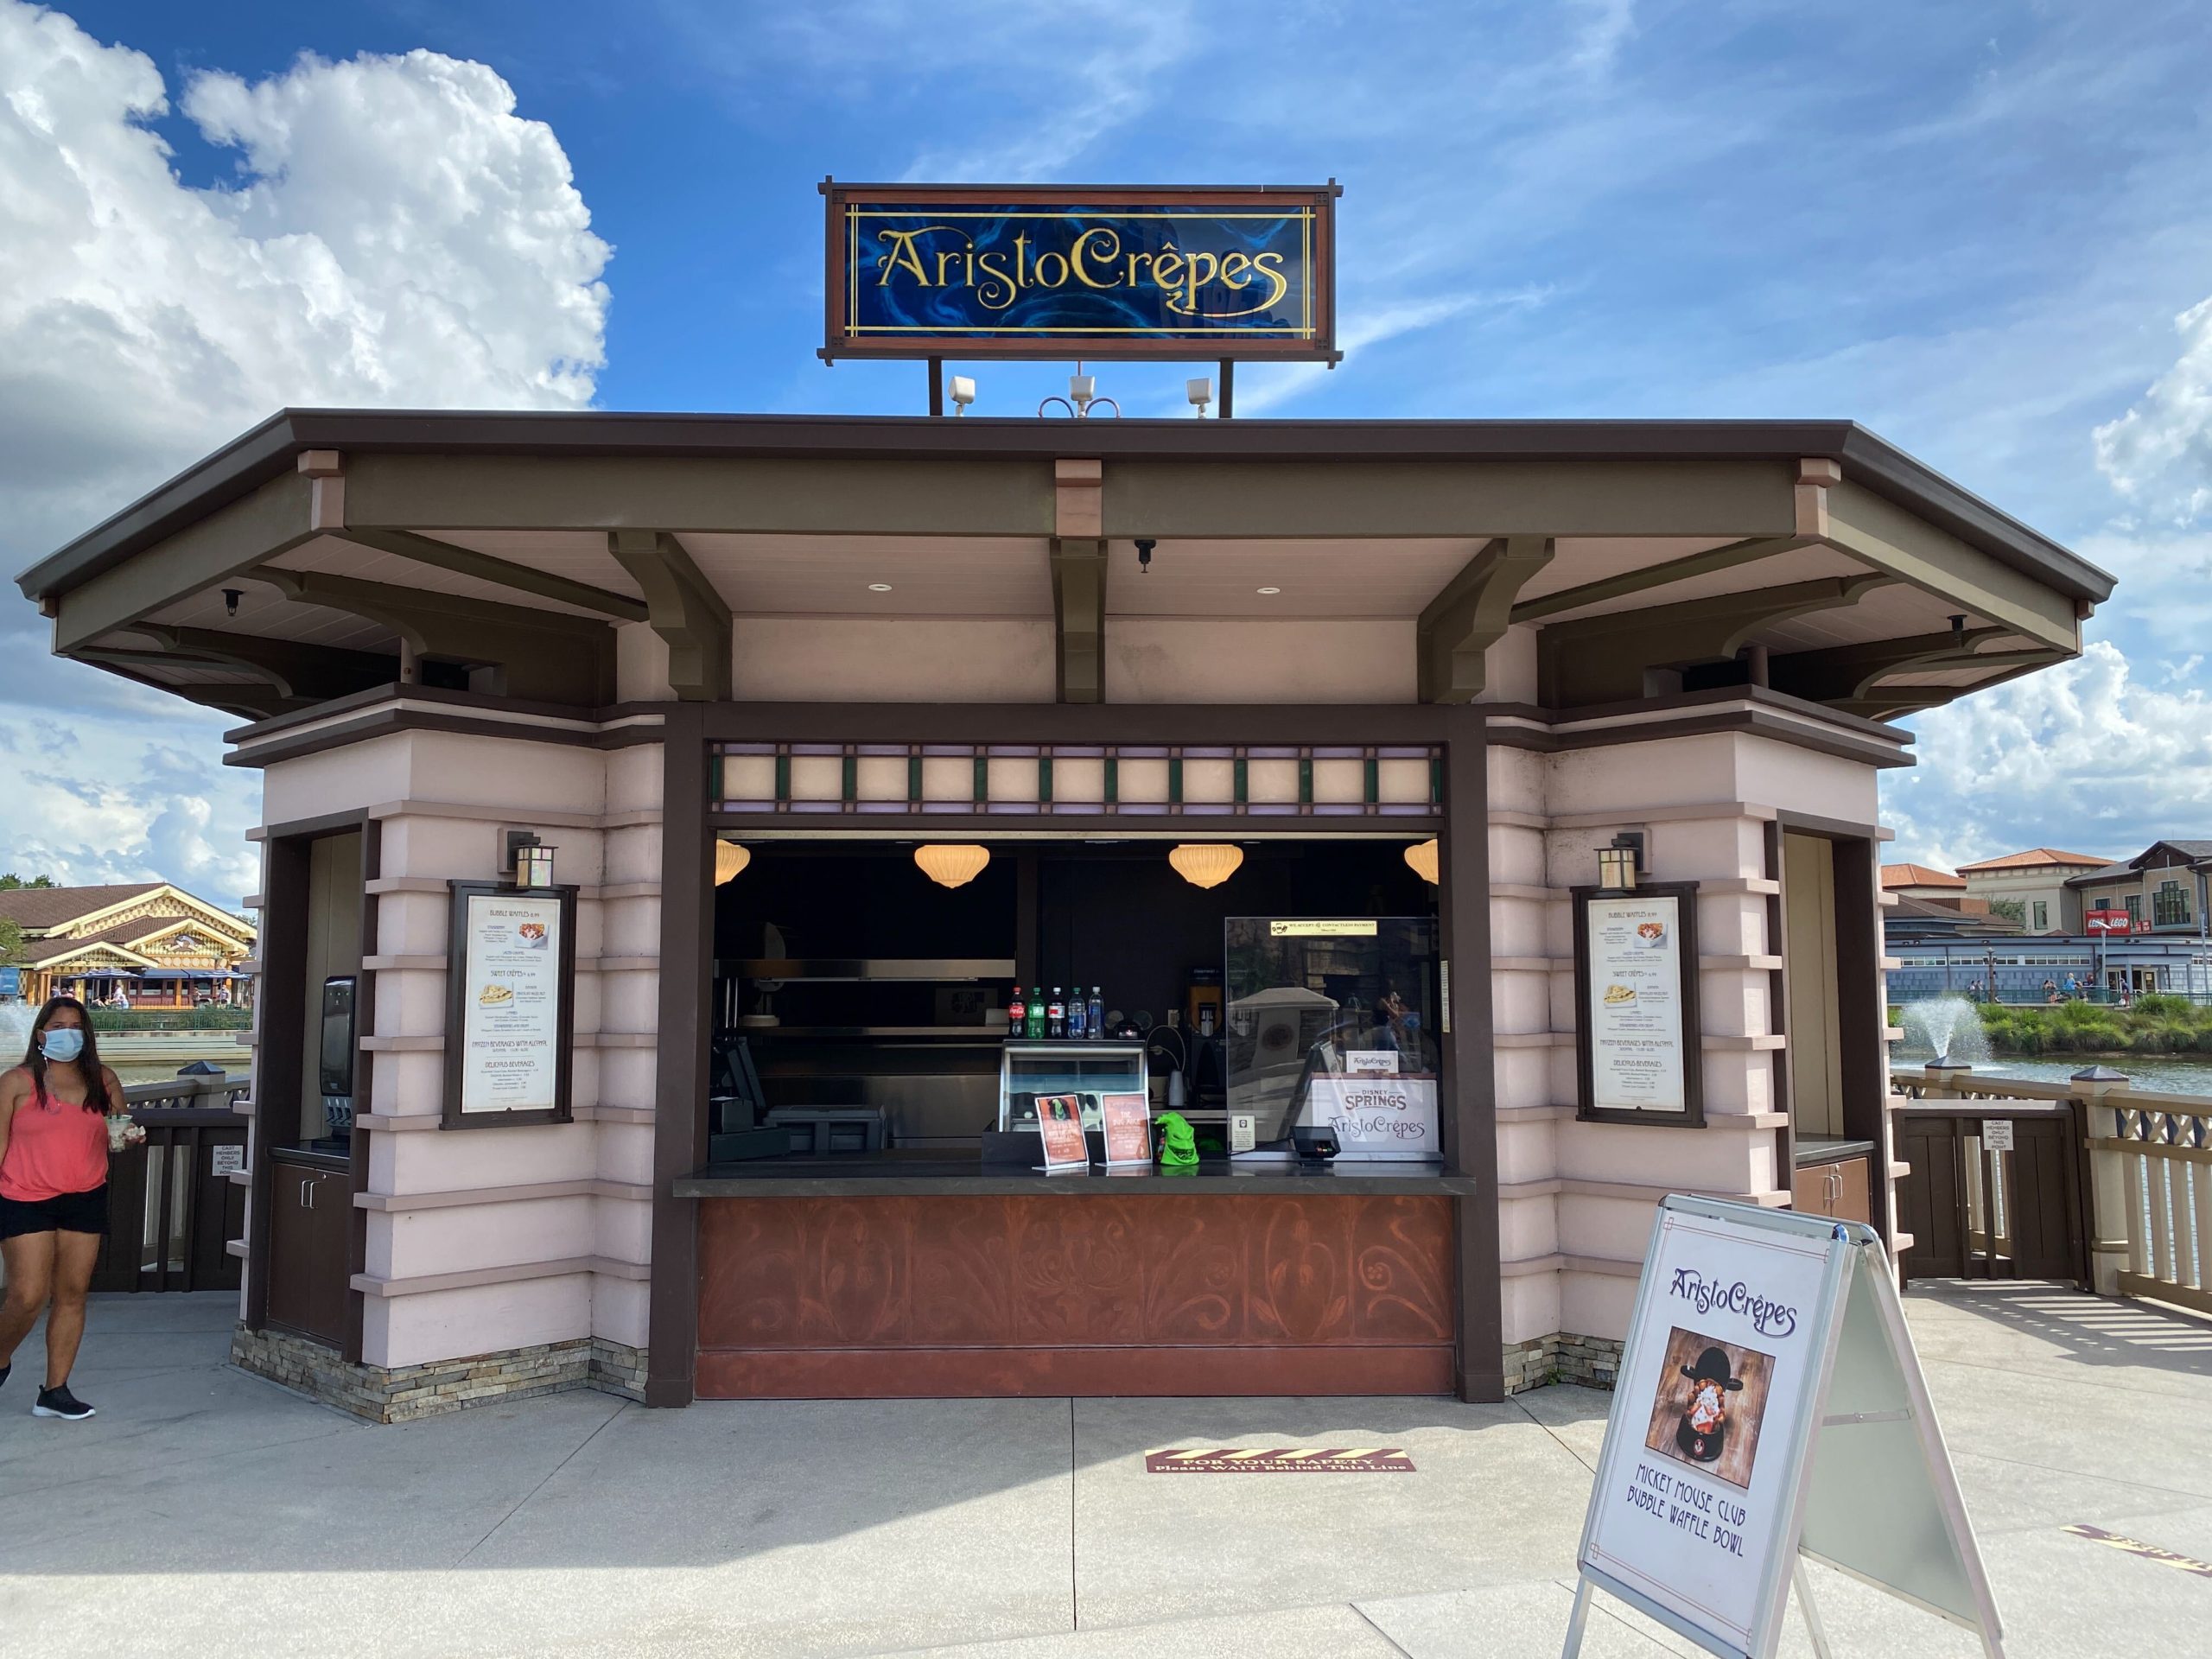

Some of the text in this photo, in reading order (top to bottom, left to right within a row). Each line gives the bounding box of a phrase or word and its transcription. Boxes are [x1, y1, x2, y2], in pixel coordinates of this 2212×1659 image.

[876, 226, 1287, 318] AristoCrêpes
[2110, 918, 2128, 927] LEGO
[1327, 1116, 1426, 1140] AristoCrêpes
[1345, 1095, 1407, 1111] SPRINGS
[1669, 1268, 1797, 1338] AristoCrêpes
[1627, 1485, 1743, 1557] BUBBLE WAFFLE BOWL
[1636, 1464, 1746, 1527] MICKEY MOUSE CLUB
